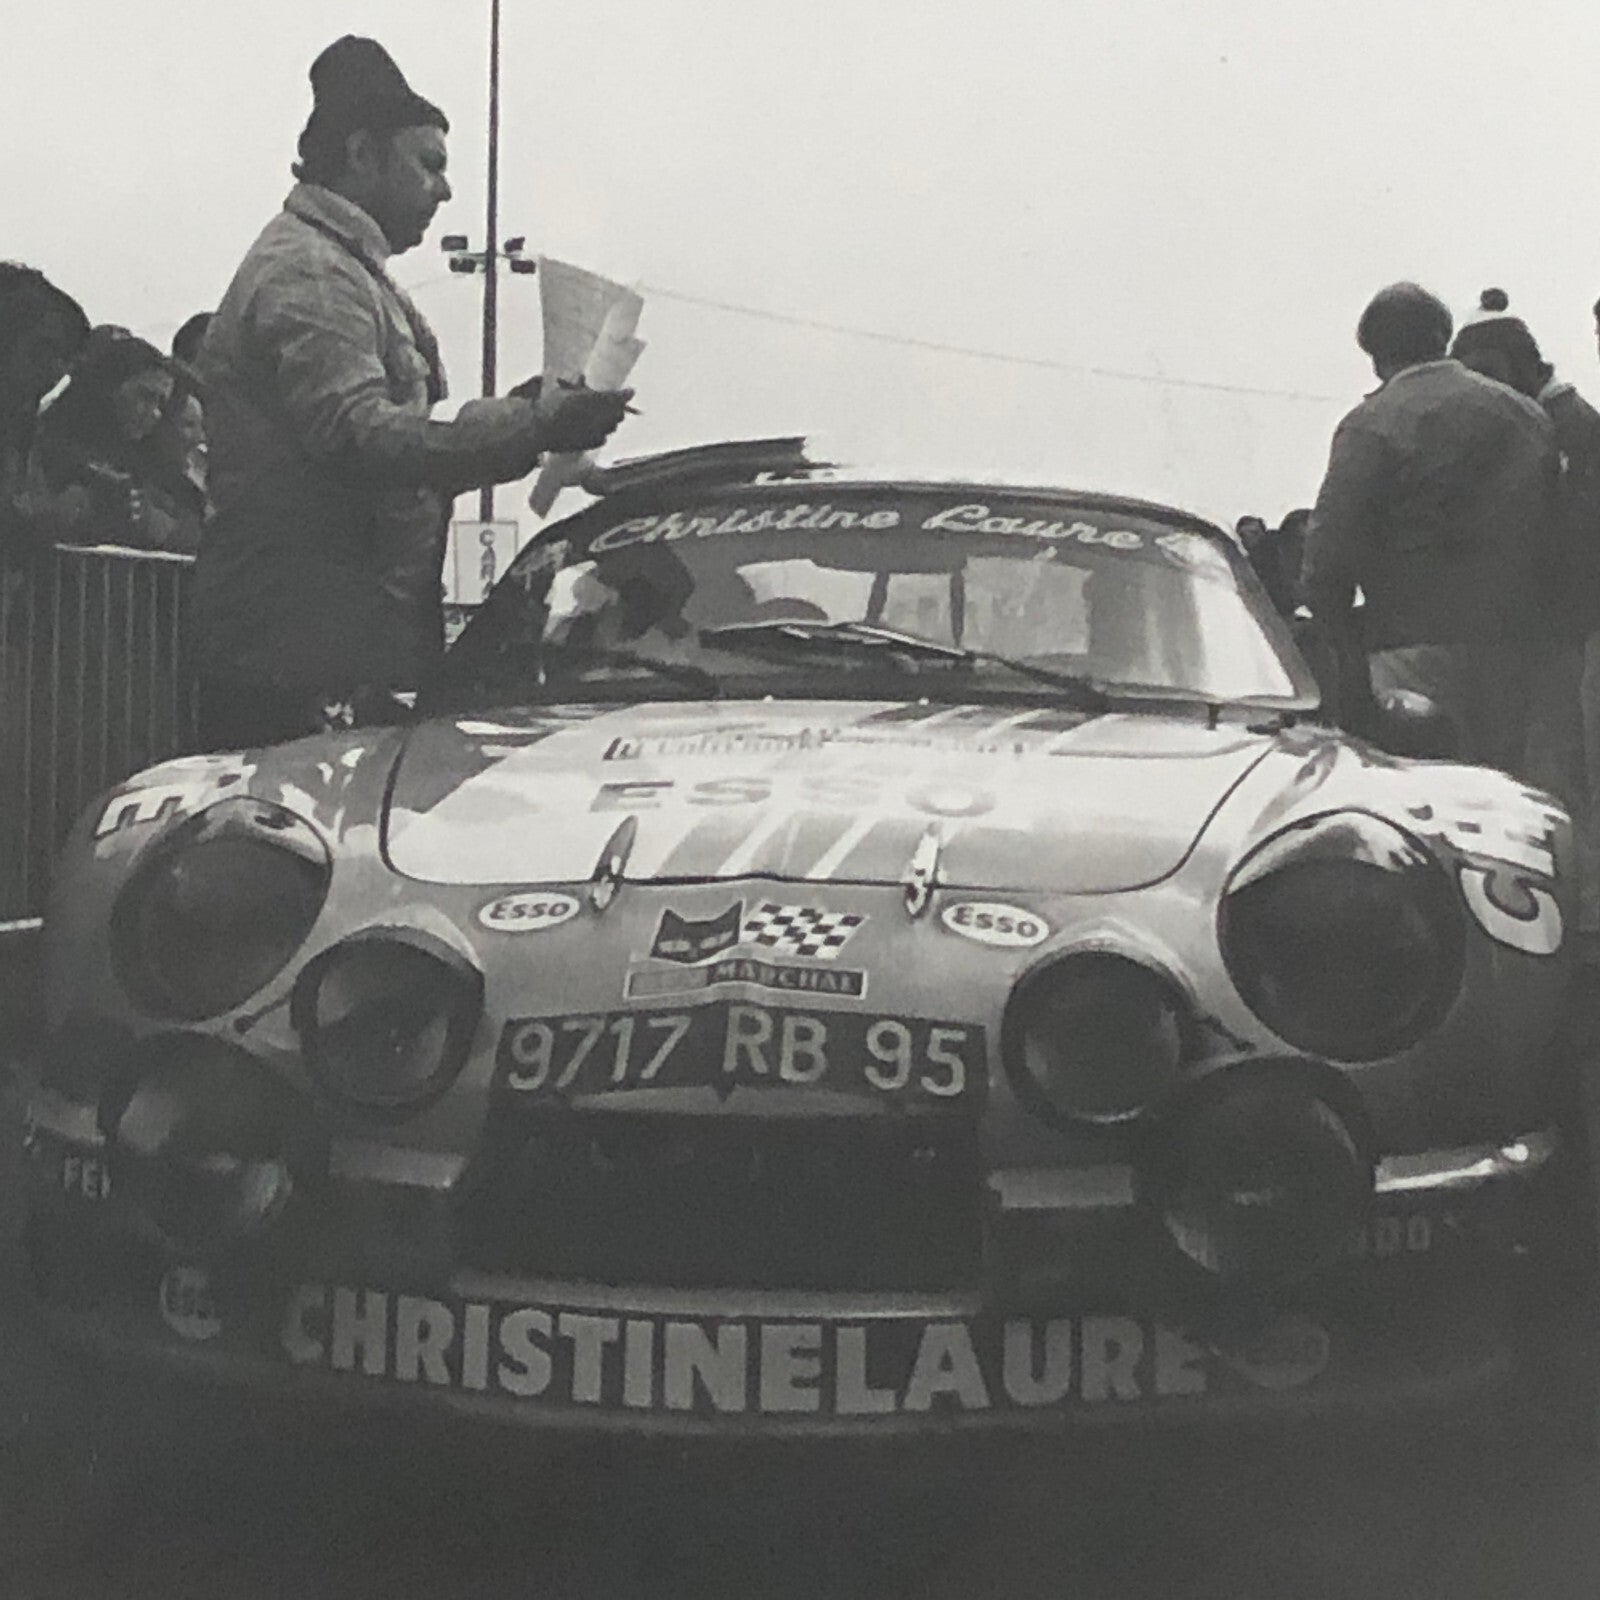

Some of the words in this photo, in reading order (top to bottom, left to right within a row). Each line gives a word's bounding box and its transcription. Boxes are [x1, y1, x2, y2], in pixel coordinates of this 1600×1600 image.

[589, 504, 900, 552] Christine
[921, 504, 1144, 550] Laure
[489, 898, 572, 922] ESSO
[952, 906, 1041, 938] ESSO
[508, 1016, 693, 1092] 9717
[723, 1004, 828, 1083] RB
[865, 1020, 967, 1097] 95
